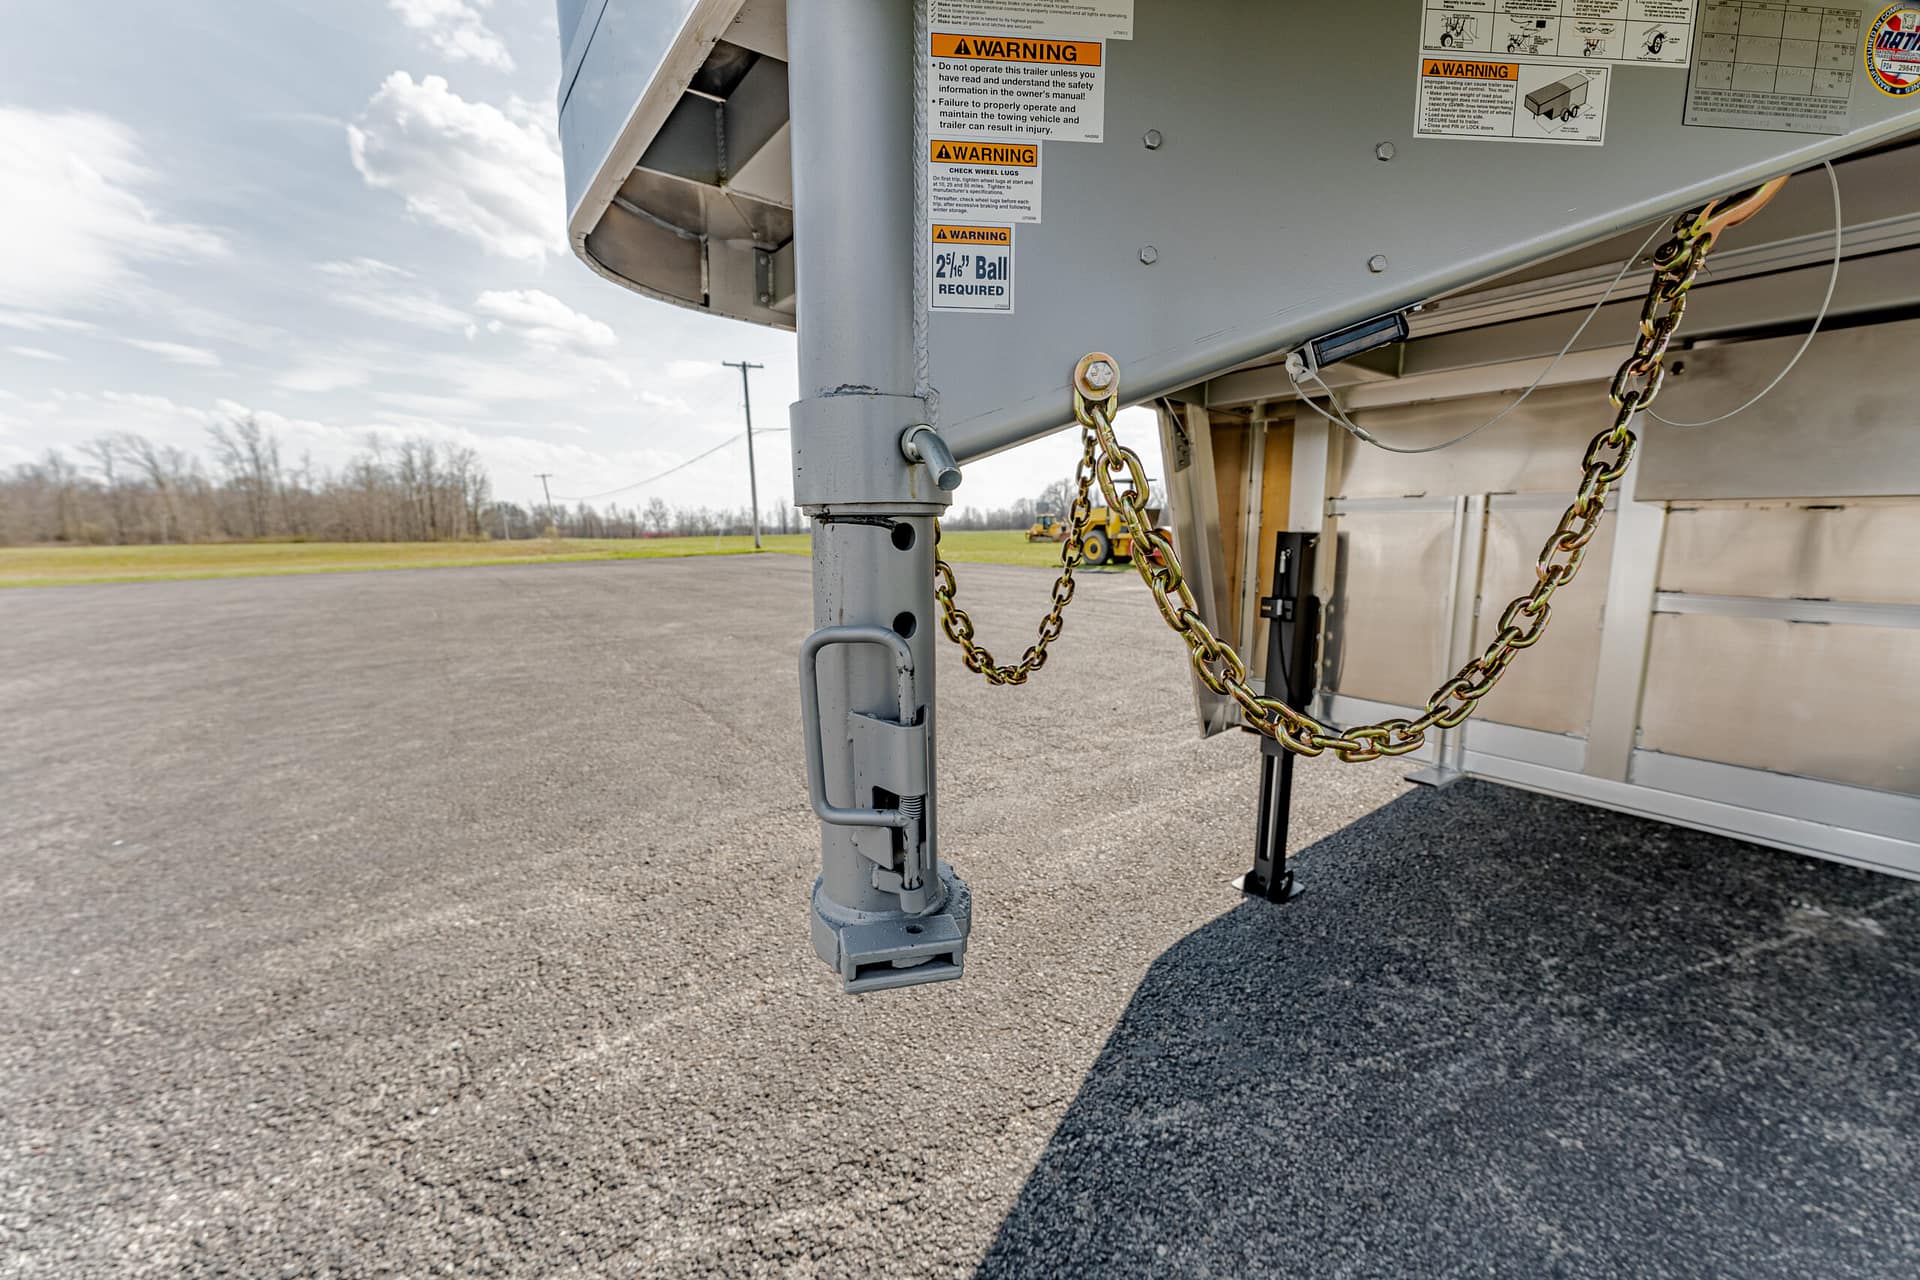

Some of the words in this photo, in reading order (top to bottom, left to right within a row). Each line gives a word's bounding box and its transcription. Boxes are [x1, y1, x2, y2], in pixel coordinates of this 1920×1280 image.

[1874, 20, 1882, 30] IN
[973, 40, 1077, 61] WARNING
[939, 62, 951, 71] Do
[953, 63, 967, 72] not
[969, 64, 1003, 75] operate
[1005, 66, 1021, 75] this
[1023, 66, 1048, 76] trailer
[1050, 68, 1078, 78] unless
[1079, 72, 1095, 80] you
[1442, 62, 1508, 78] WARNING
[939, 74, 959, 83] have
[961, 75, 982, 84] read
[983, 76, 1000, 85] and
[1001, 77, 1050, 87] understand
[1052, 79, 1066, 88] the
[1067, 80, 1094, 91] safety
[939, 85, 988, 95] information
[990, 87, 999, 96] in
[1000, 87, 1014, 97] the
[1016, 89, 1050, 99] owner's
[1052, 90, 1085, 100] manual!
[939, 98, 969, 107] Failure
[971, 100, 981, 108] to
[983, 101, 1021, 111] properly
[1023, 103, 1057, 114] operate
[1059, 104, 1076, 113] and
[940, 110, 978, 119] maintain
[980, 111, 995, 120] the
[997, 112, 1027, 123] towing
[1029, 113, 1061, 124] vehicle
[1063, 115, 1080, 124] and
[940, 121, 966, 129] trailer
[968, 123, 985, 131] can
[987, 123, 1013, 132] result
[1015, 125, 1024, 133] in
[1025, 125, 1052, 135] injury.
[953, 146, 1034, 163] WARNING
[949, 230, 1007, 241] WARNING
[976, 255, 1007, 280] Ball
[939, 284, 1004, 296] REQUIRED
